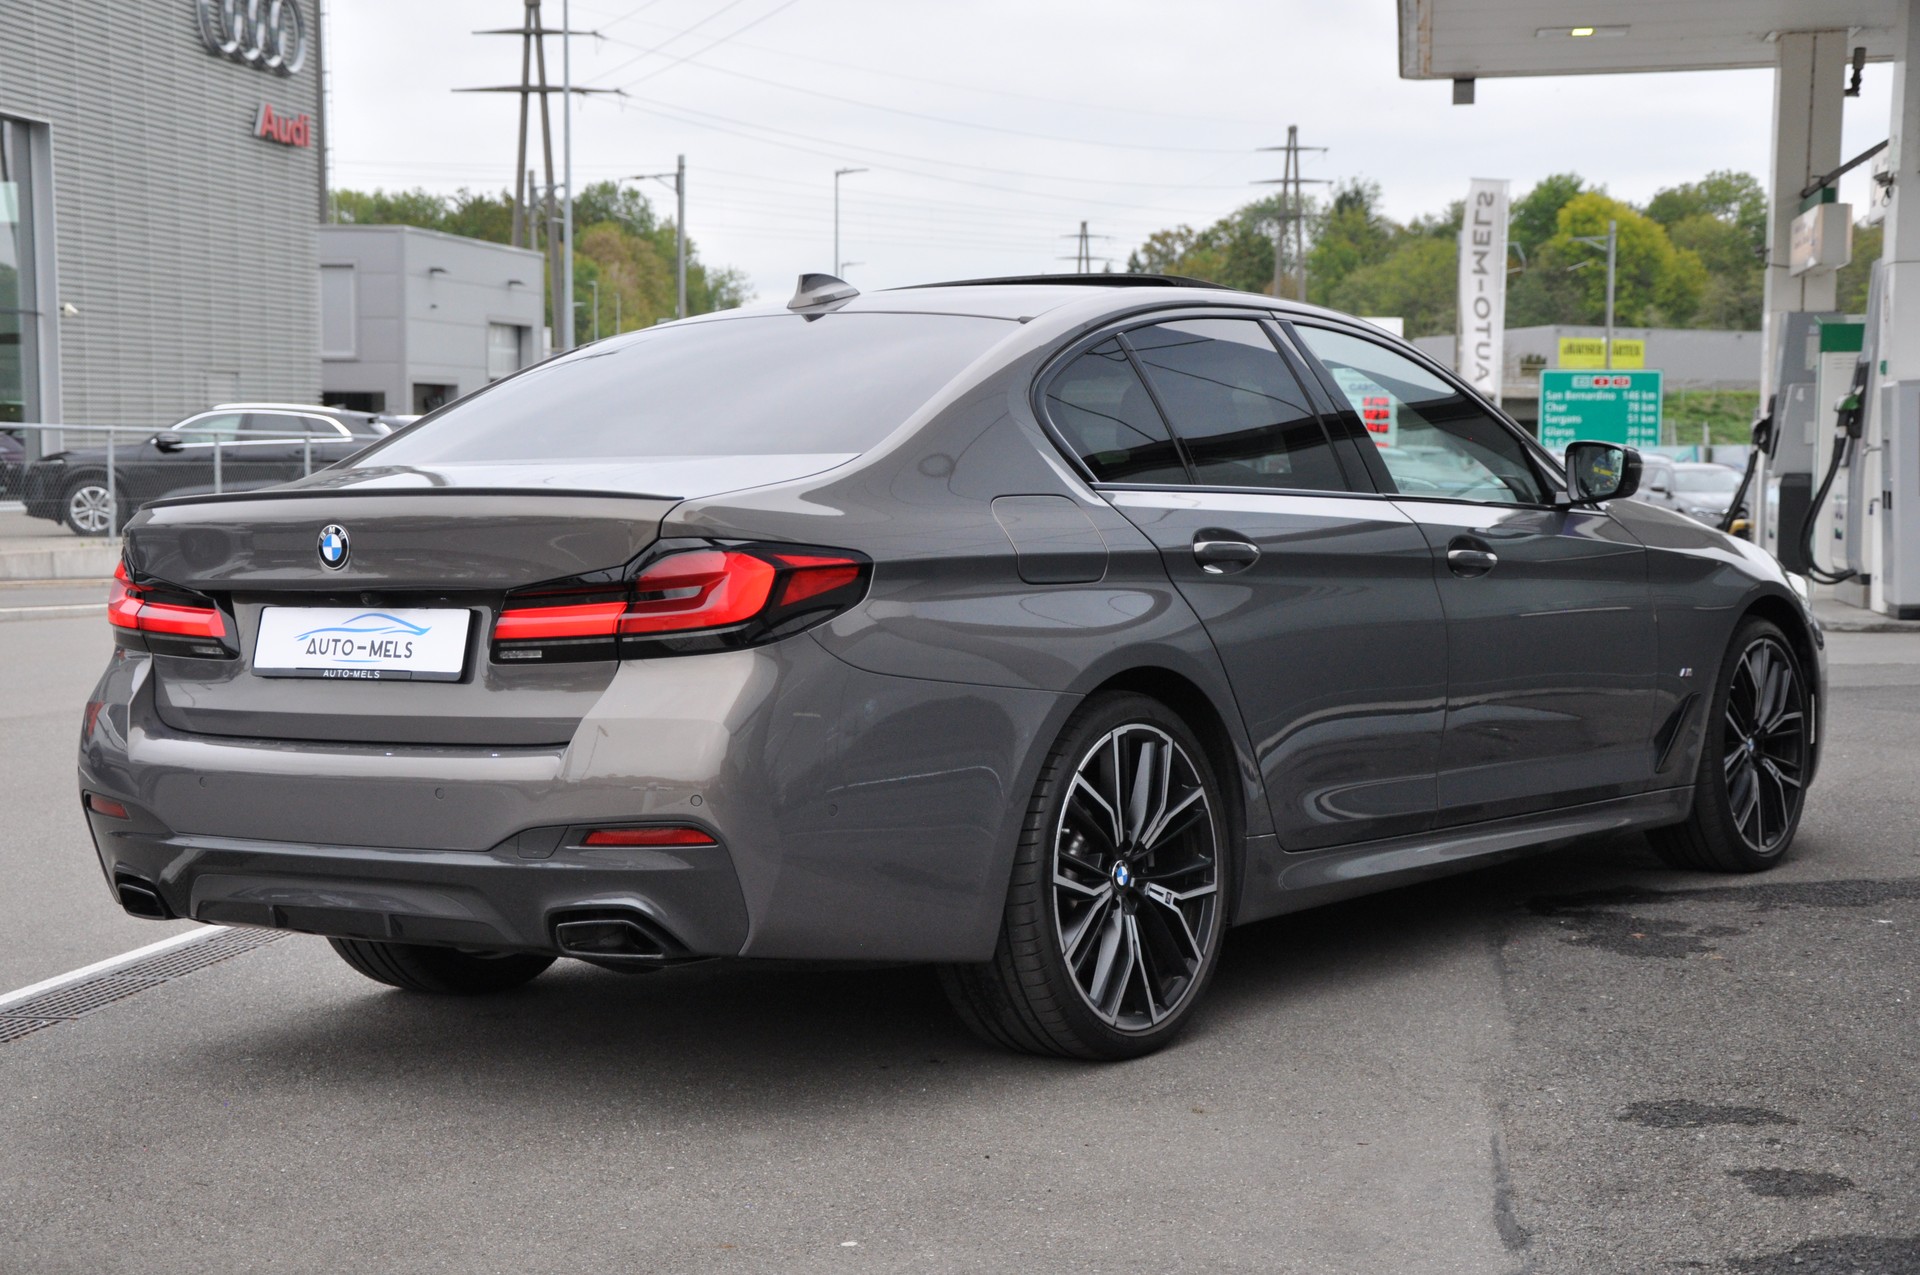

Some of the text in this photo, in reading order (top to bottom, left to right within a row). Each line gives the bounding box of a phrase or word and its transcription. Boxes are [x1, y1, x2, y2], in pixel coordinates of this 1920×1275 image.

[259, 102, 311, 147] Audi
[1545, 390, 1563, 400] San
[1564, 390, 1616, 400] Bernardino
[1641, 390, 1657, 400] km
[1544, 402, 1567, 412] Chur
[1641, 402, 1657, 412] km
[1544, 413, 1582, 425] Sargans
[1640, 413, 1656, 423] km
[1544, 426, 1575, 437] Glarus
[1640, 426, 1656, 437] km
[305, 637, 413, 659] AUTO-MELS
[322, 669, 381, 679] AUTO-MELS
